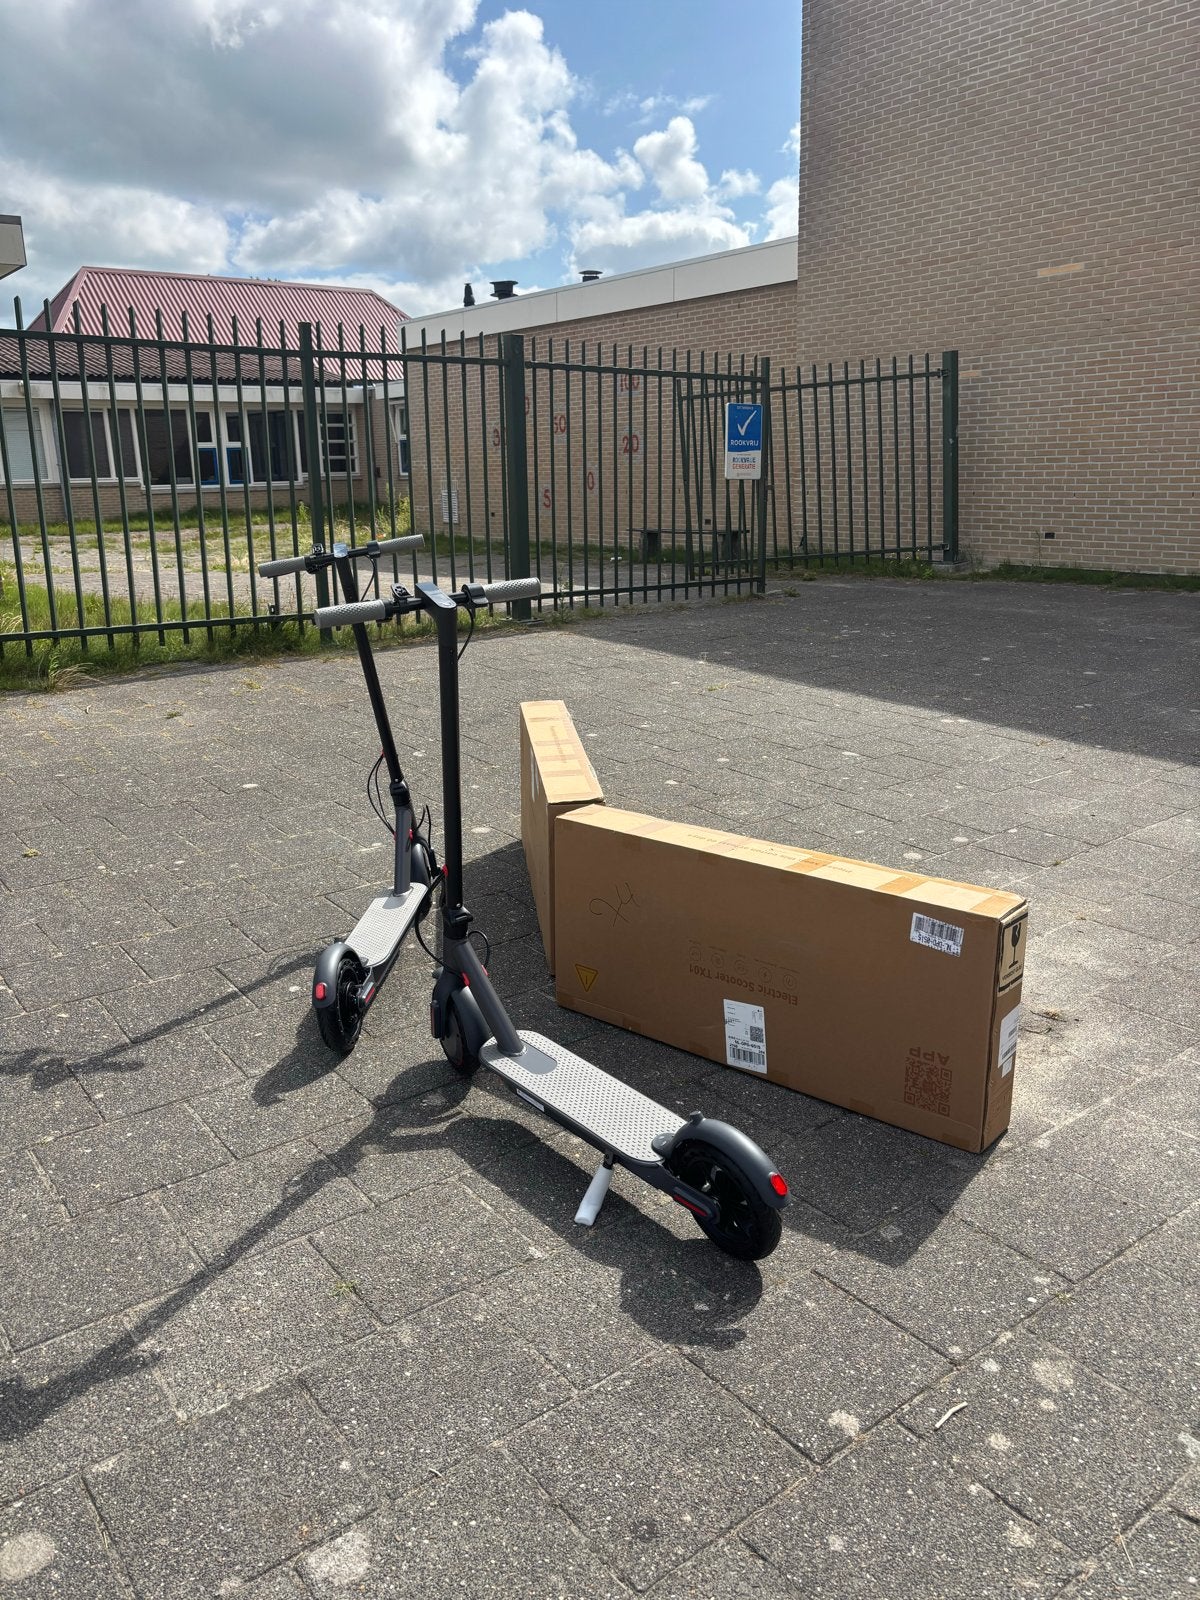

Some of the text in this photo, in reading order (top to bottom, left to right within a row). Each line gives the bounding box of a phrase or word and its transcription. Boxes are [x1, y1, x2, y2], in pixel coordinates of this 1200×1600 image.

[622, 434, 640, 454] 20
[730, 439, 759, 447] ROOKVRIJ
[689, 964, 799, 1006] Electric Scooter TX01
[909, 1047, 950, 1066] APP
